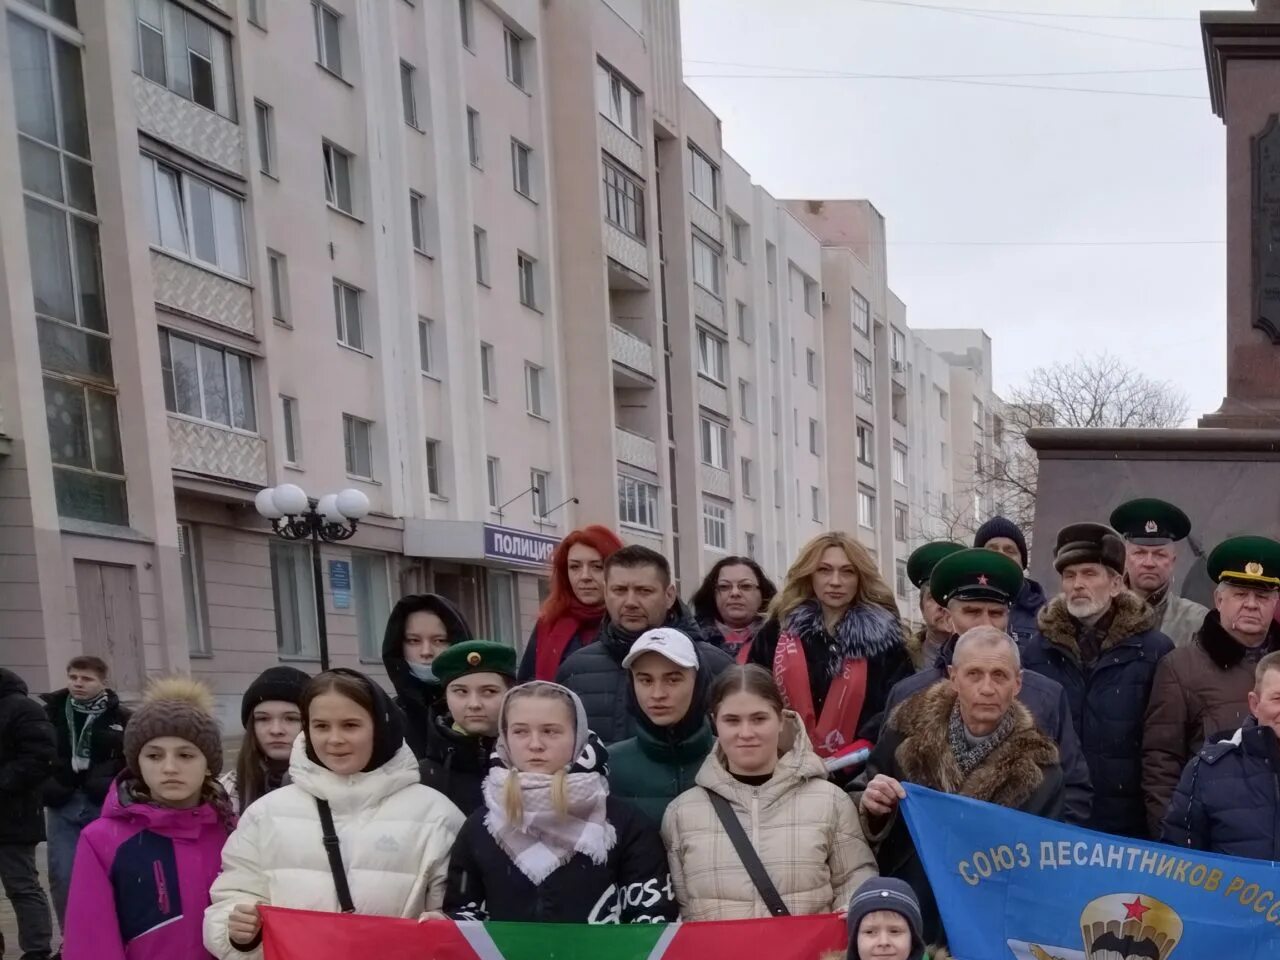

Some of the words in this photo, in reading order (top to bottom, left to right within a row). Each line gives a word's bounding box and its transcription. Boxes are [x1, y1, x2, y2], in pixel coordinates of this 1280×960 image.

[494, 532, 554, 562] ПОЛИЦИЯ
[958, 842, 1031, 887] СОЮЗ
[1039, 840, 1224, 892] ДЕСАНТНИКОВ
